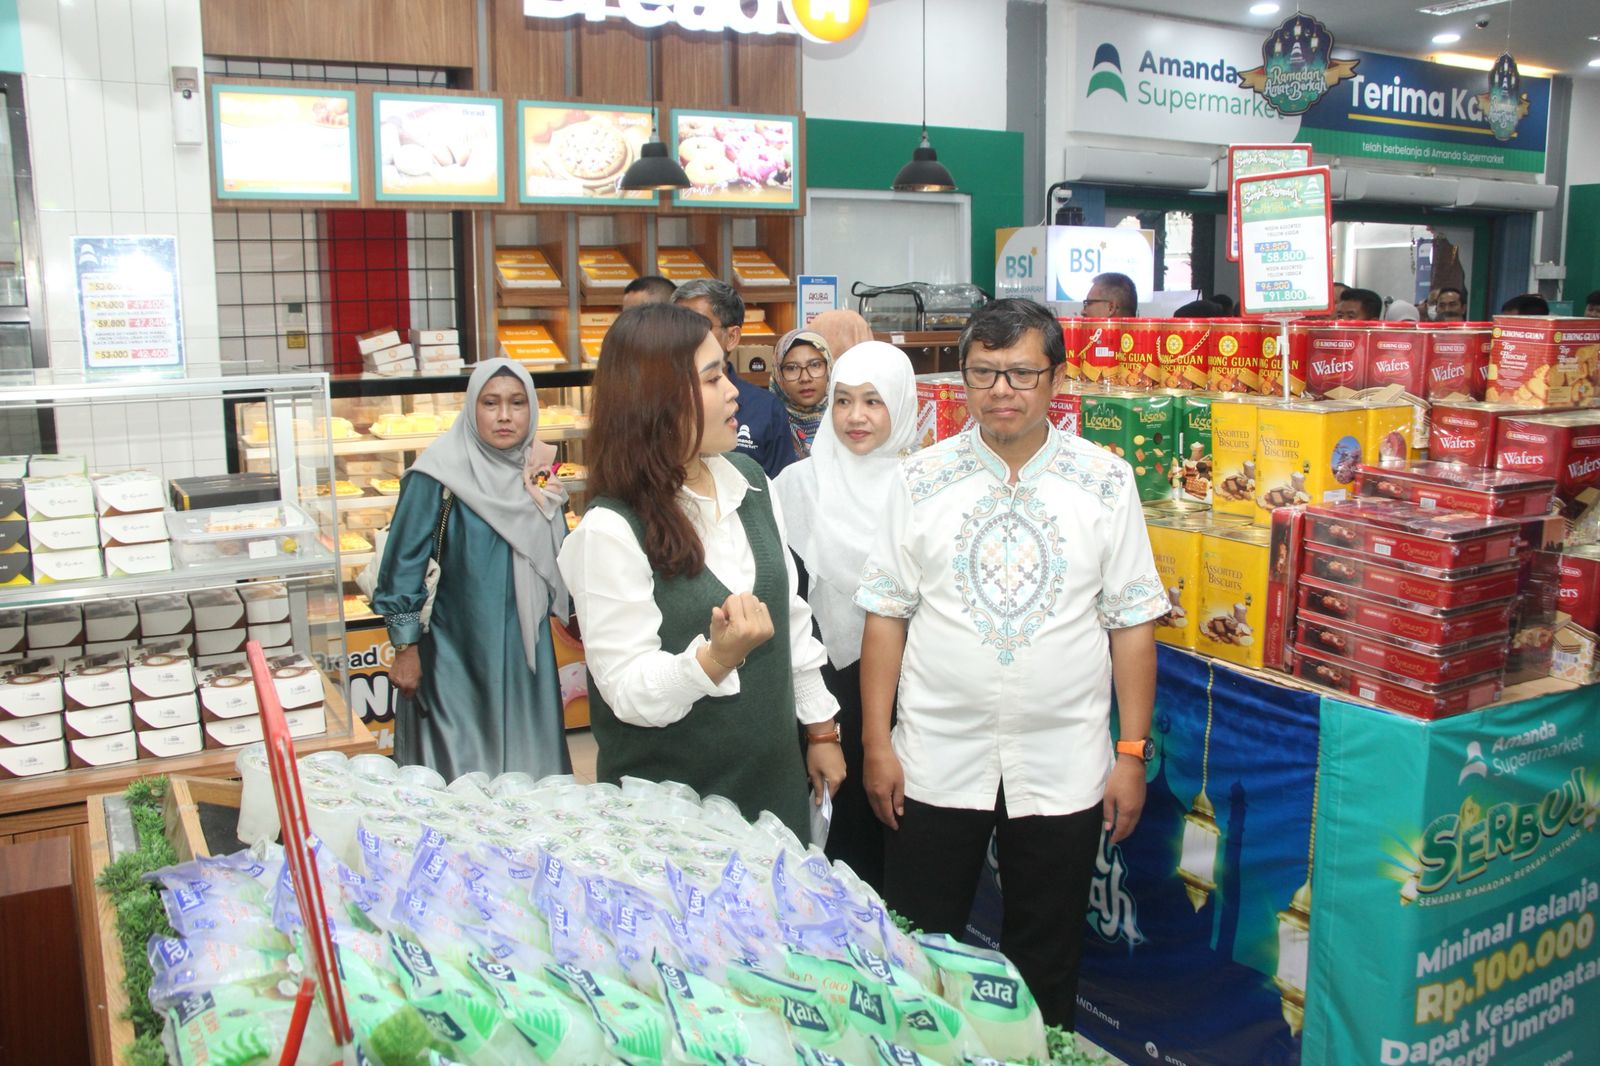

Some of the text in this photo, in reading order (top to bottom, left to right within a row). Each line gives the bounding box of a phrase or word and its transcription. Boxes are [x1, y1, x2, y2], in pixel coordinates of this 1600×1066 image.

[1138, 50, 1238, 85] Amanda
[1270, 64, 1320, 86] Ramadan
[1138, 80, 1285, 120] Supermarke
[1350, 74, 1445, 118] Terima
[1363, 141, 1505, 164] telah berbelanja di Amanda Supermarket
[1006, 255, 1033, 278] BSI
[1070, 247, 1101, 273] BSI
[1267, 250, 1304, 262] 58.800
[1269, 290, 1304, 301] 91.800
[1501, 330, 1525, 338] KHONG
[1501, 341, 1516, 351] Top
[1129, 353, 1153, 362] GUAN
[1231, 357, 1259, 367] GUAN
[1271, 360, 1299, 370] GUN
[1312, 358, 1354, 376] Wafers
[1376, 359, 1410, 373] Wafers
[1431, 363, 1465, 382] Wafers
[1085, 411, 1122, 431] Legend
[1139, 411, 1167, 423] Legend
[1264, 445, 1299, 460] BISCUITS
[1439, 435, 1476, 449] Wafers
[1504, 451, 1544, 466] Wafers
[1400, 541, 1441, 562] Dynasty
[1203, 561, 1243, 581] ASSORTED
[1208, 573, 1242, 591] BISCUITS
[1559, 584, 1578, 598] ers
[1491, 720, 1557, 754] Amanda
[1492, 733, 1585, 776] Supermarket
[1416, 767, 1587, 892] SERBU!
[422, 849, 447, 883] kara
[545, 856, 562, 888] kara
[1465, 875, 1511, 897] RAMADAN
[1514, 855, 1547, 880] BERKAH
[1549, 830, 1582, 859] UNTUNG
[689, 887, 706, 918] kara
[617, 905, 636, 936] kara
[1416, 877, 1599, 978] Minimal Belanja
[1415, 911, 1596, 1025] Rp.100.000
[822, 978, 849, 992] Coco
[972, 979, 1013, 1004] kara
[786, 999, 823, 1026] kara
[1502, 995, 1575, 1048] Umroh
[1380, 1019, 1470, 1066] Dapat
